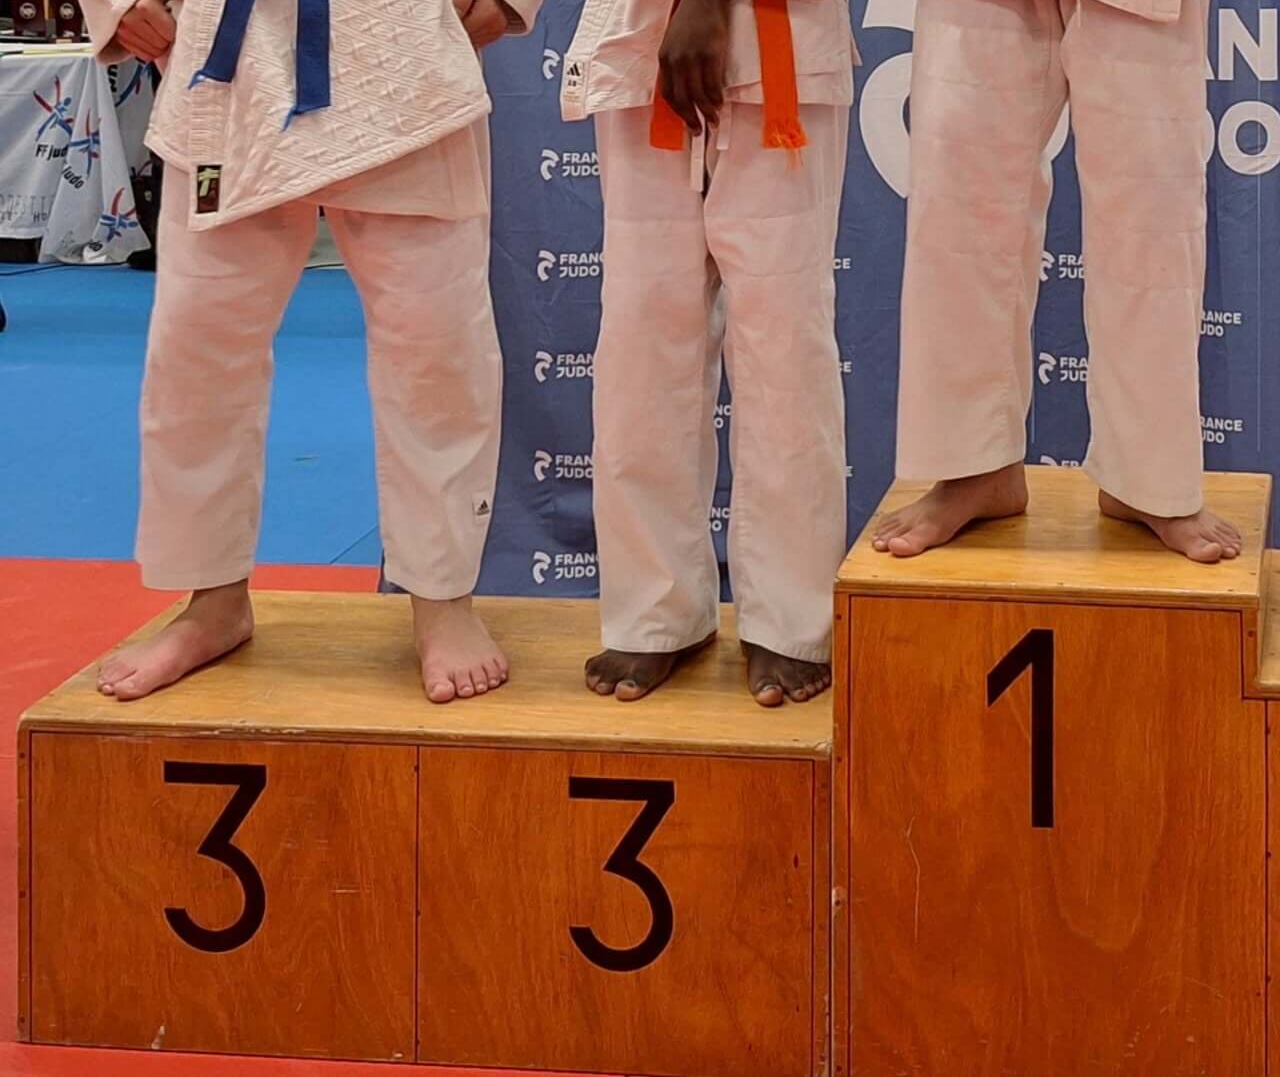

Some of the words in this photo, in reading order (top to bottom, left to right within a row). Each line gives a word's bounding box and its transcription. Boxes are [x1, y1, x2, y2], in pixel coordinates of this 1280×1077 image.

[562, 152, 599, 164] FRAN
[562, 165, 600, 177] JUDO
[560, 253, 605, 264] FRAN
[559, 265, 600, 277] JUDO
[1058, 267, 1085, 279] JUD
[1200, 311, 1242, 324] RANCE
[1200, 324, 1224, 337] UDO
[557, 353, 593, 366] FRAN
[1060, 357, 1088, 369] FRA
[1060, 370, 1088, 381] JUD
[1200, 417, 1243, 432] RANCE
[555, 454, 593, 466] FRAN
[555, 553, 600, 566] FRAN
[555, 565, 596, 579] JUDO
[987, 628, 1055, 828] 1
[164, 760, 267, 953] 3
[569, 776, 676, 972] 3
